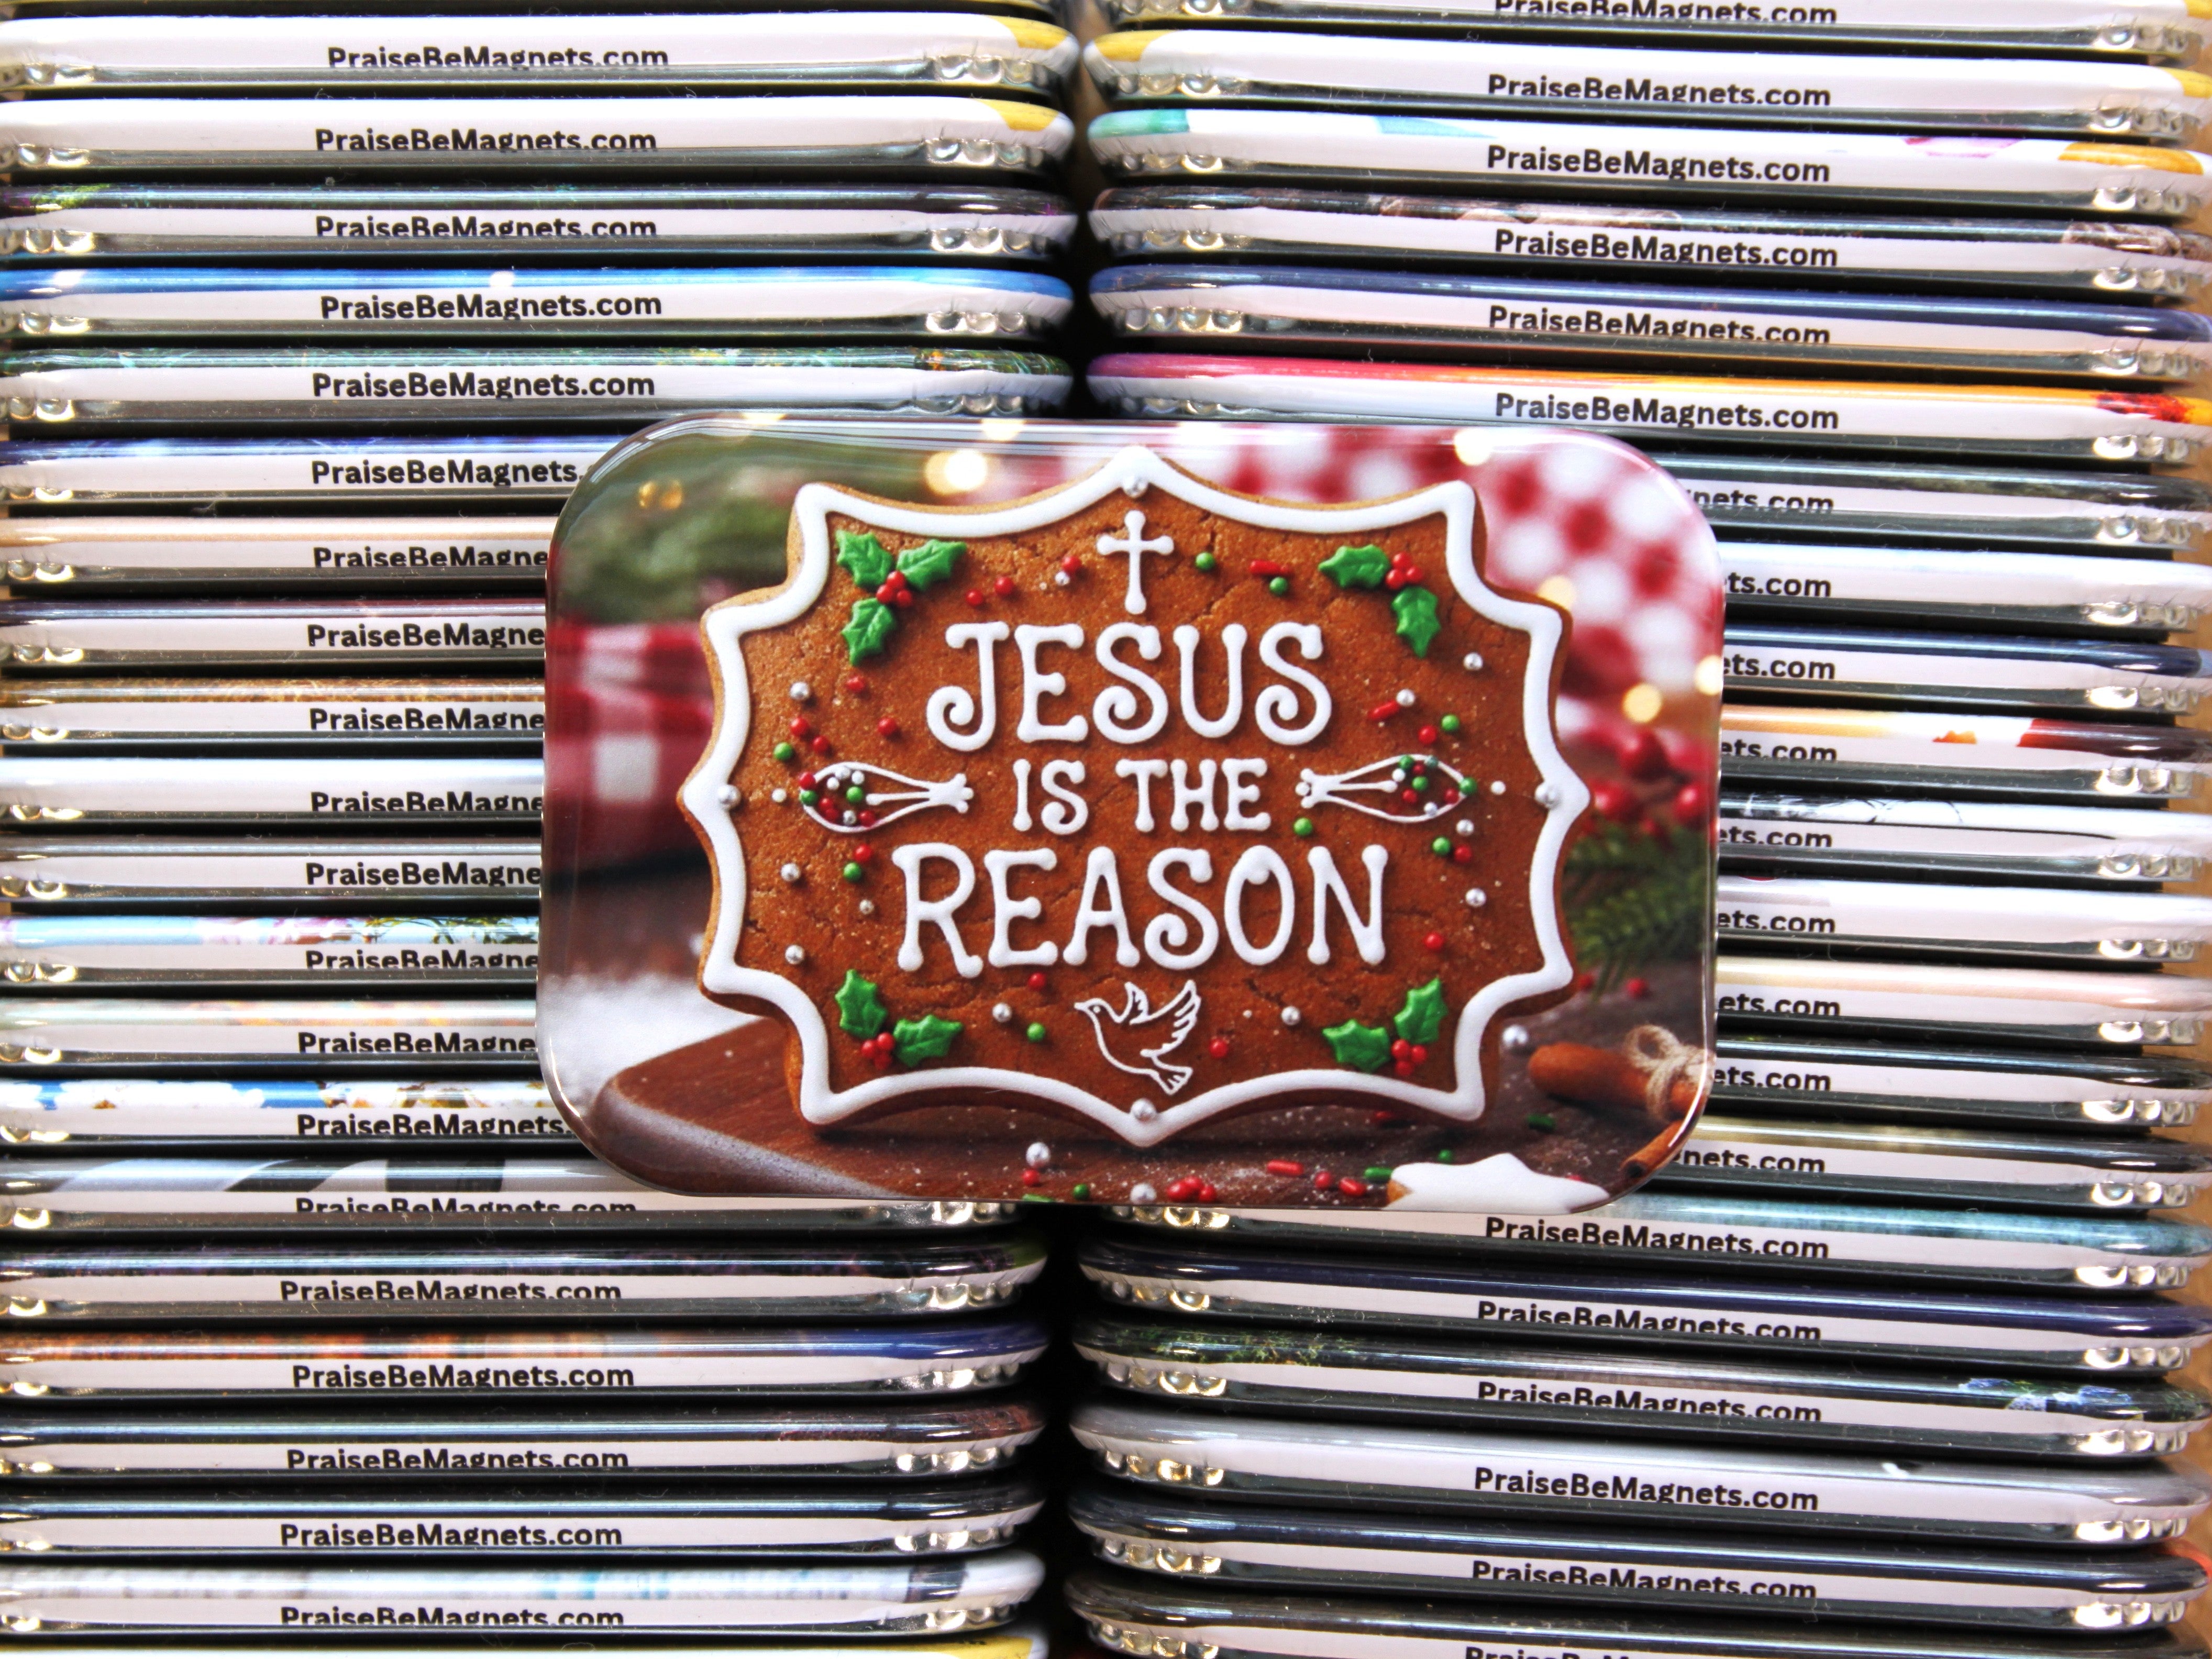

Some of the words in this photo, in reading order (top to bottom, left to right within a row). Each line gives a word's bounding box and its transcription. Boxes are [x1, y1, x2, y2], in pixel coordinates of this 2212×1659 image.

[328, 46, 668, 69] PraiseBeMagnets.com
[1489, 74, 1831, 106] PraiseBeMagnets.com
[316, 128, 656, 151] PraiseBeMagnets.com
[1488, 145, 1830, 182] PraiseBeMagnets.com
[316, 216, 656, 237] PraiseBeMagnets.com
[1495, 229, 1838, 267] PraiseBeMagnets.com
[320, 294, 661, 319] PraiseBeMagnets.com
[1489, 305, 1830, 344] PraiseBeMagnets.com
[313, 372, 655, 399] PraiseBeMagnets.com
[1496, 392, 1839, 429] PraiseBeMagnets.com
[312, 459, 593, 486] PraiseBeMagnets.
[1724, 571, 1831, 597] ts.com
[926, 622, 1333, 753] JESUS
[1014, 759, 1088, 834] IS
[1115, 759, 1271, 834] THE
[892, 844, 1389, 979] REASON
[1486, 1216, 1829, 1258] PraiseBeMagnets.com
[293, 1364, 634, 1388] PraiseBeMagnets.com
[1474, 1467, 1818, 1510] PraiseBeMagnets.com
[281, 1523, 622, 1545] PraiseBeMagnets.com
